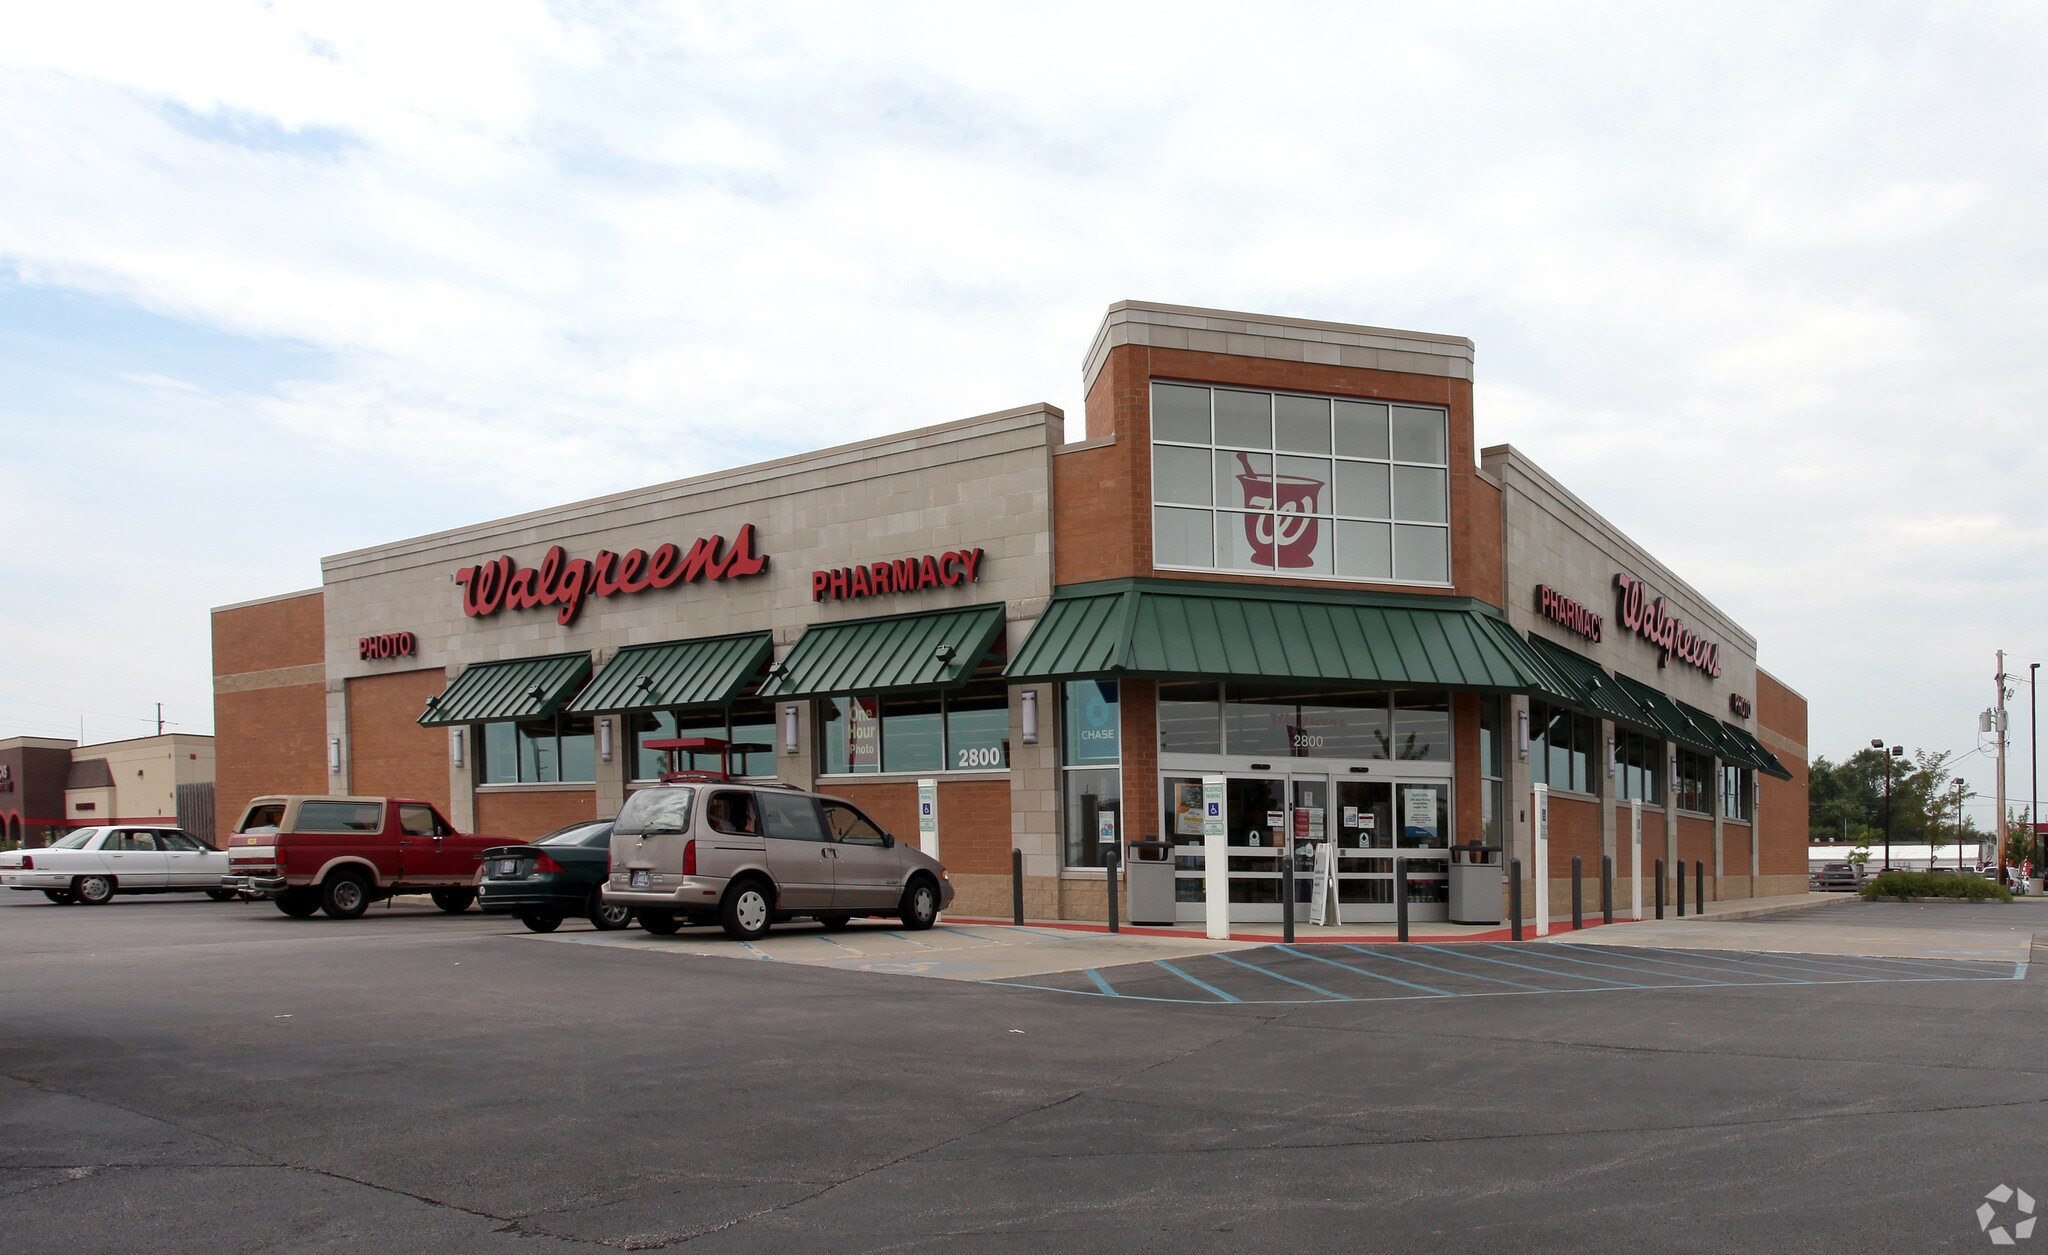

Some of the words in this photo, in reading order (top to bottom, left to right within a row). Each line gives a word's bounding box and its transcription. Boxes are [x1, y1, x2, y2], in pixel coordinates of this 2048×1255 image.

[455, 522, 770, 626] Walgreens
[812, 547, 984, 602] PHARMACY
[1536, 583, 1604, 643] PHARMACY
[1614, 573, 1721, 678] Walgreens
[359, 630, 416, 660] PHOTO
[849, 705, 873, 722] One
[847, 723, 876, 740] Hour
[1081, 729, 1115, 740] CHASE
[1293, 734, 1324, 748] 2800
[849, 743, 875, 755] Photo
[958, 747, 1000, 768] 2800
